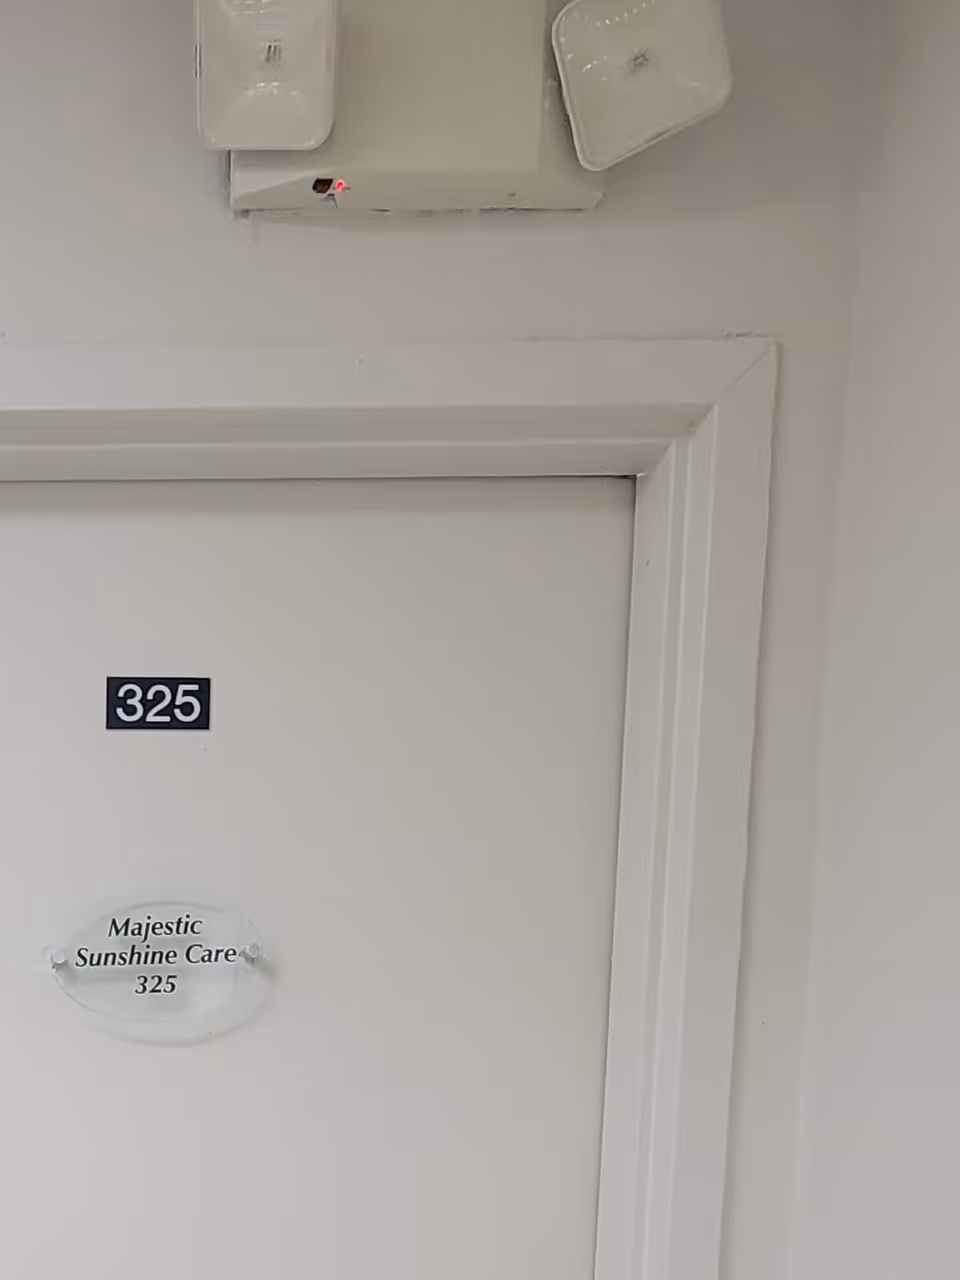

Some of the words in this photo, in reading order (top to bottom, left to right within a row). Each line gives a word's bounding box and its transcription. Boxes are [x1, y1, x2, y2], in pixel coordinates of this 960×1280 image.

[116, 683, 201, 722] 325
[108, 914, 203, 943] Majestic
[75, 945, 177, 967] Sunshine
[185, 944, 237, 964] Care
[134, 975, 177, 994] 325
